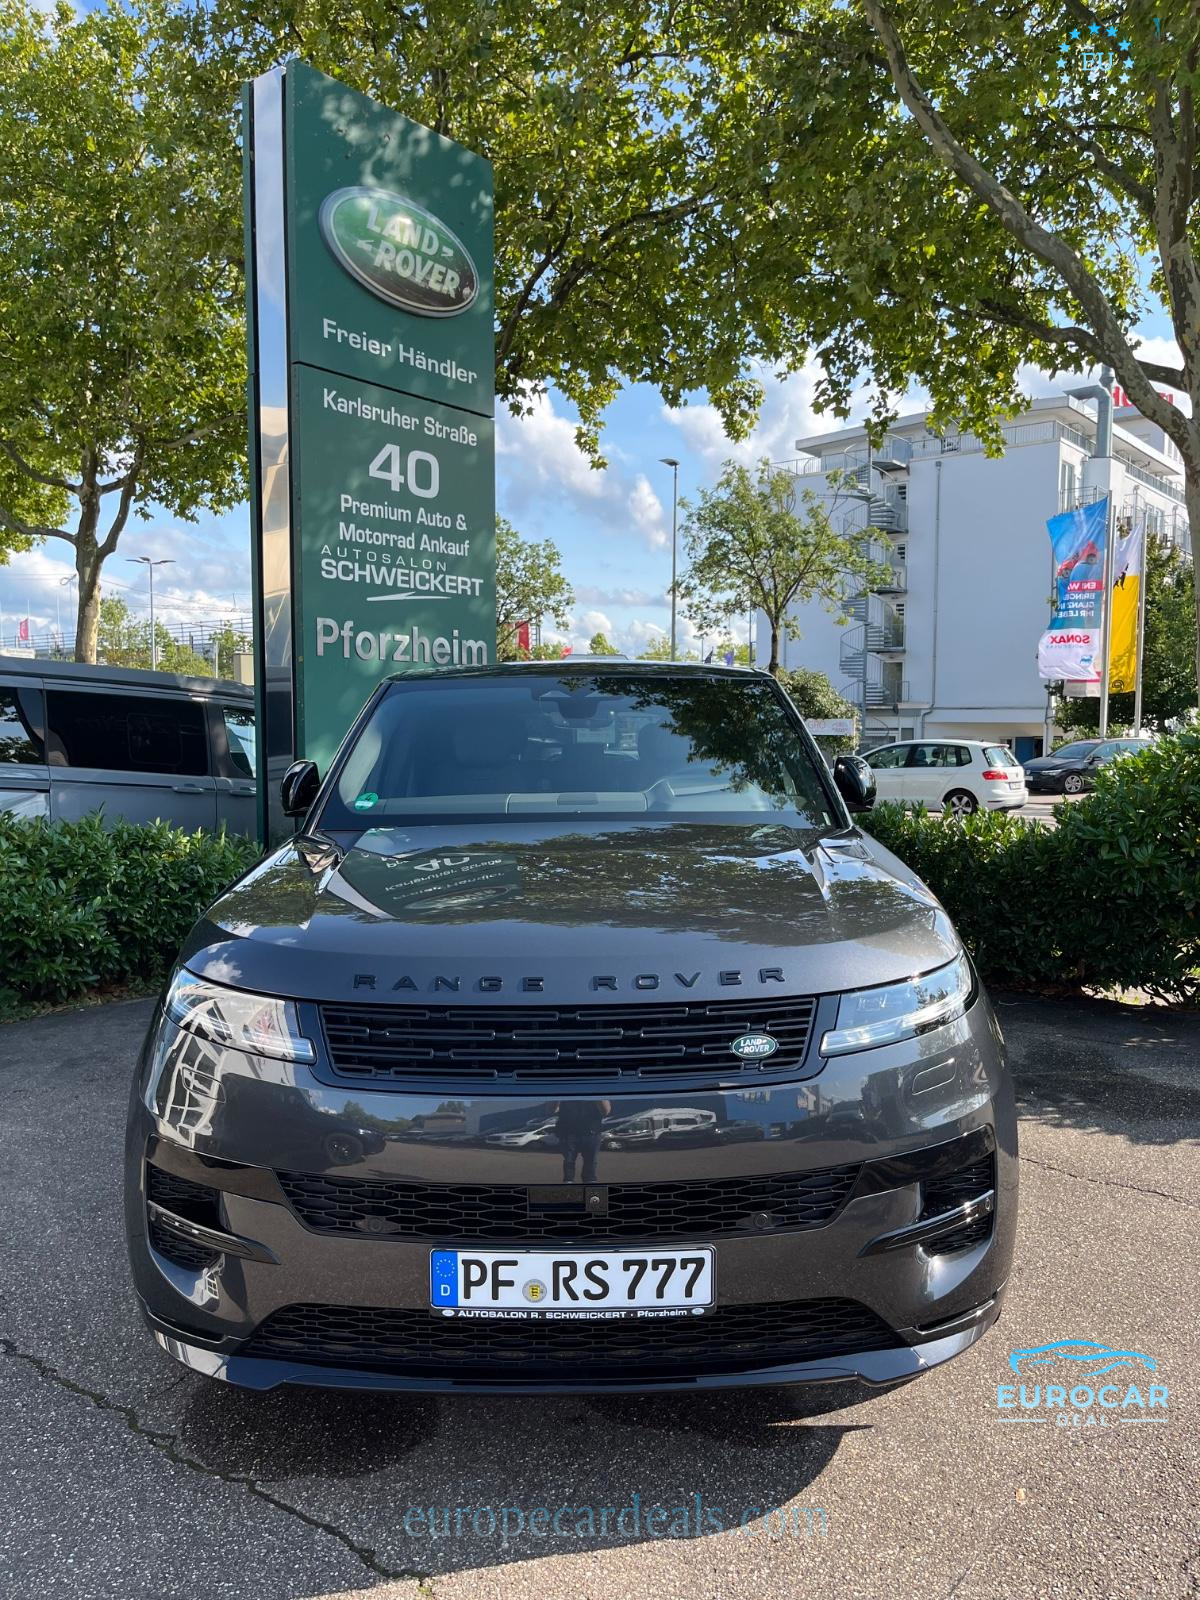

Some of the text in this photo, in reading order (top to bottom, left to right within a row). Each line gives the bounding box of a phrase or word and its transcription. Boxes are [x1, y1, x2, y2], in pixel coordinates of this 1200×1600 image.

[366, 206, 440, 256] LAND
[374, 240, 461, 298] ROVER
[323, 318, 478, 384] Freier Händler
[323, 388, 478, 446] Karlsruher Straße
[368, 443, 440, 499] 40
[340, 494, 468, 531] Premium Auto &
[321, 544, 447, 572] AUTOSALON
[339, 522, 470, 557] Motorrad Ankauf
[321, 558, 484, 597] SCHWEICKERT
[316, 616, 488, 666] Pforzheim
[352, 967, 786, 992] RANGE ROVER
[740, 1038, 763, 1047] LAND
[743, 1044, 770, 1054] ROVER
[440, 1285, 451, 1296] D
[461, 1259, 519, 1301] PF
[552, 1260, 610, 1301] RS
[622, 1257, 706, 1300] 777
[458, 1308, 688, 1319] AUTOSALON R. SCHWEICKERT Pforzheim
